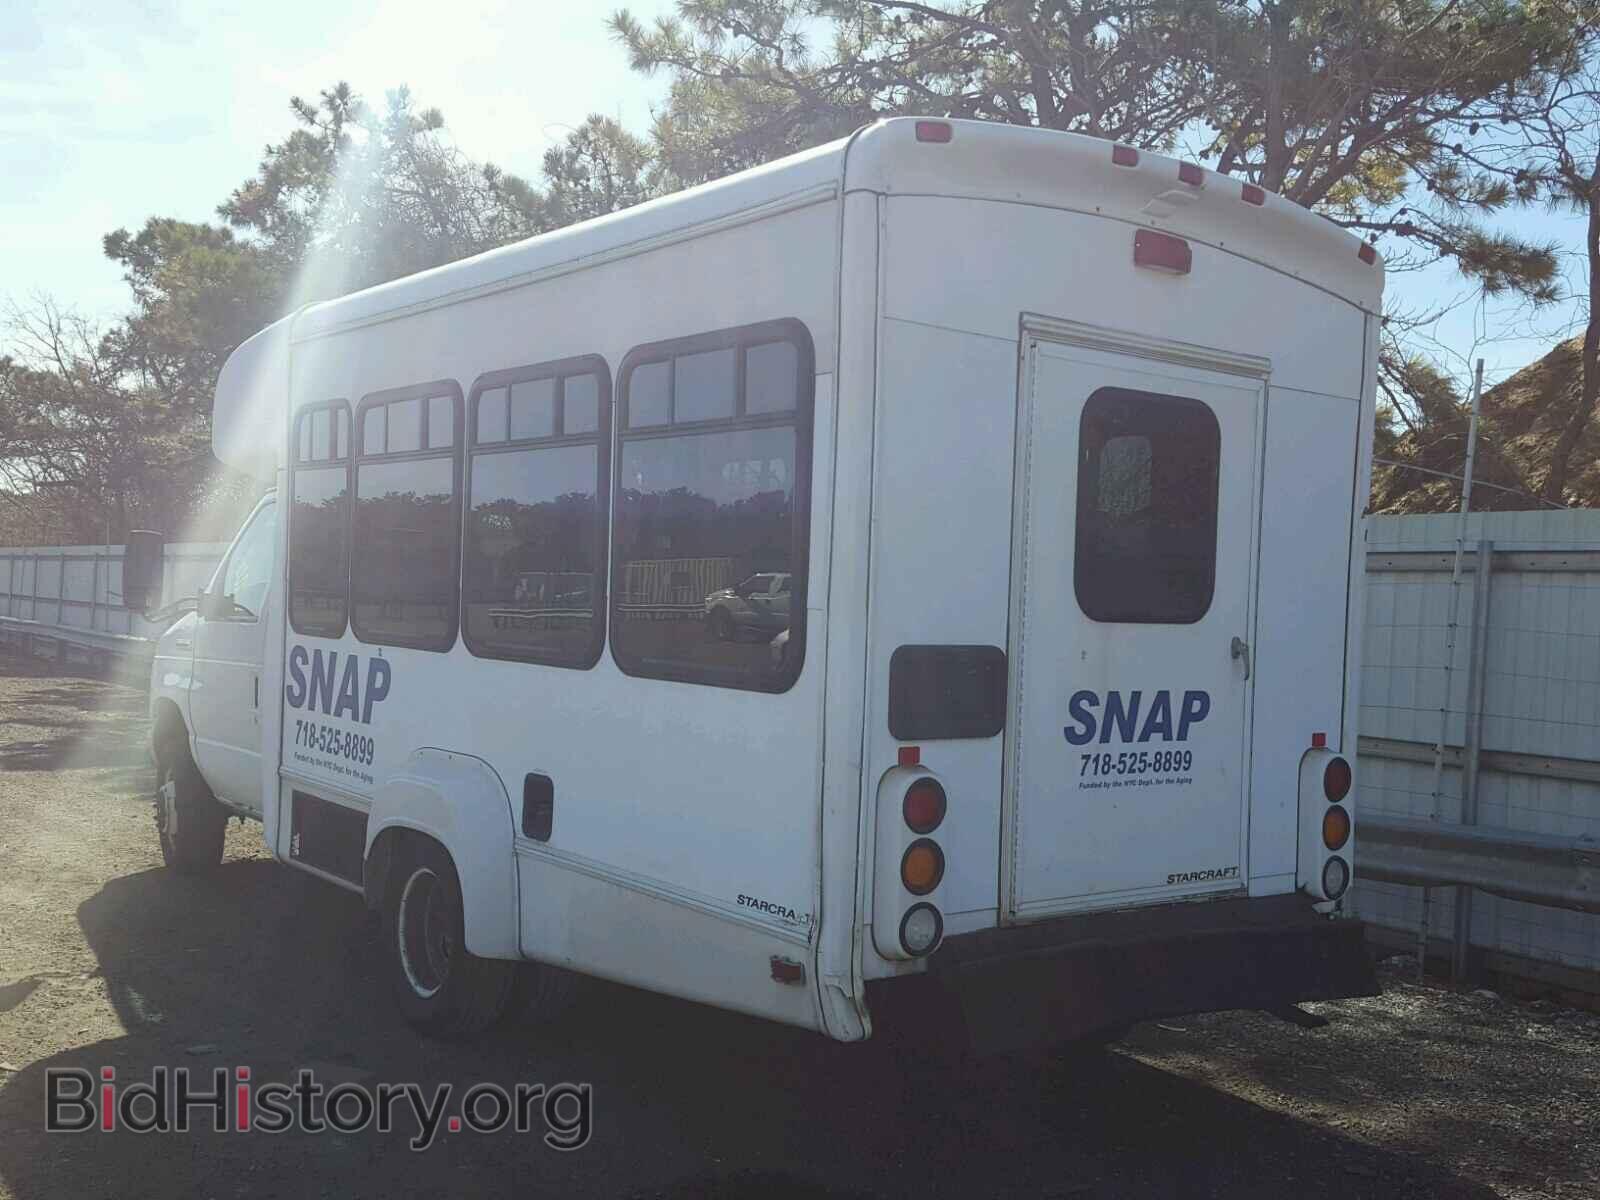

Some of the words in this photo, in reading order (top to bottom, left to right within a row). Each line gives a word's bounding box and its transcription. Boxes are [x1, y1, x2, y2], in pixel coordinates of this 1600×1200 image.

[286, 645, 391, 724] SNAP
[1063, 690, 1210, 745] SNAP
[295, 720, 374, 765] 718-525-8899
[1080, 750, 1192, 776] 718-525-8899
[1167, 866, 1238, 884] STARCRAFT
[737, 894, 810, 924] STARCRAT
